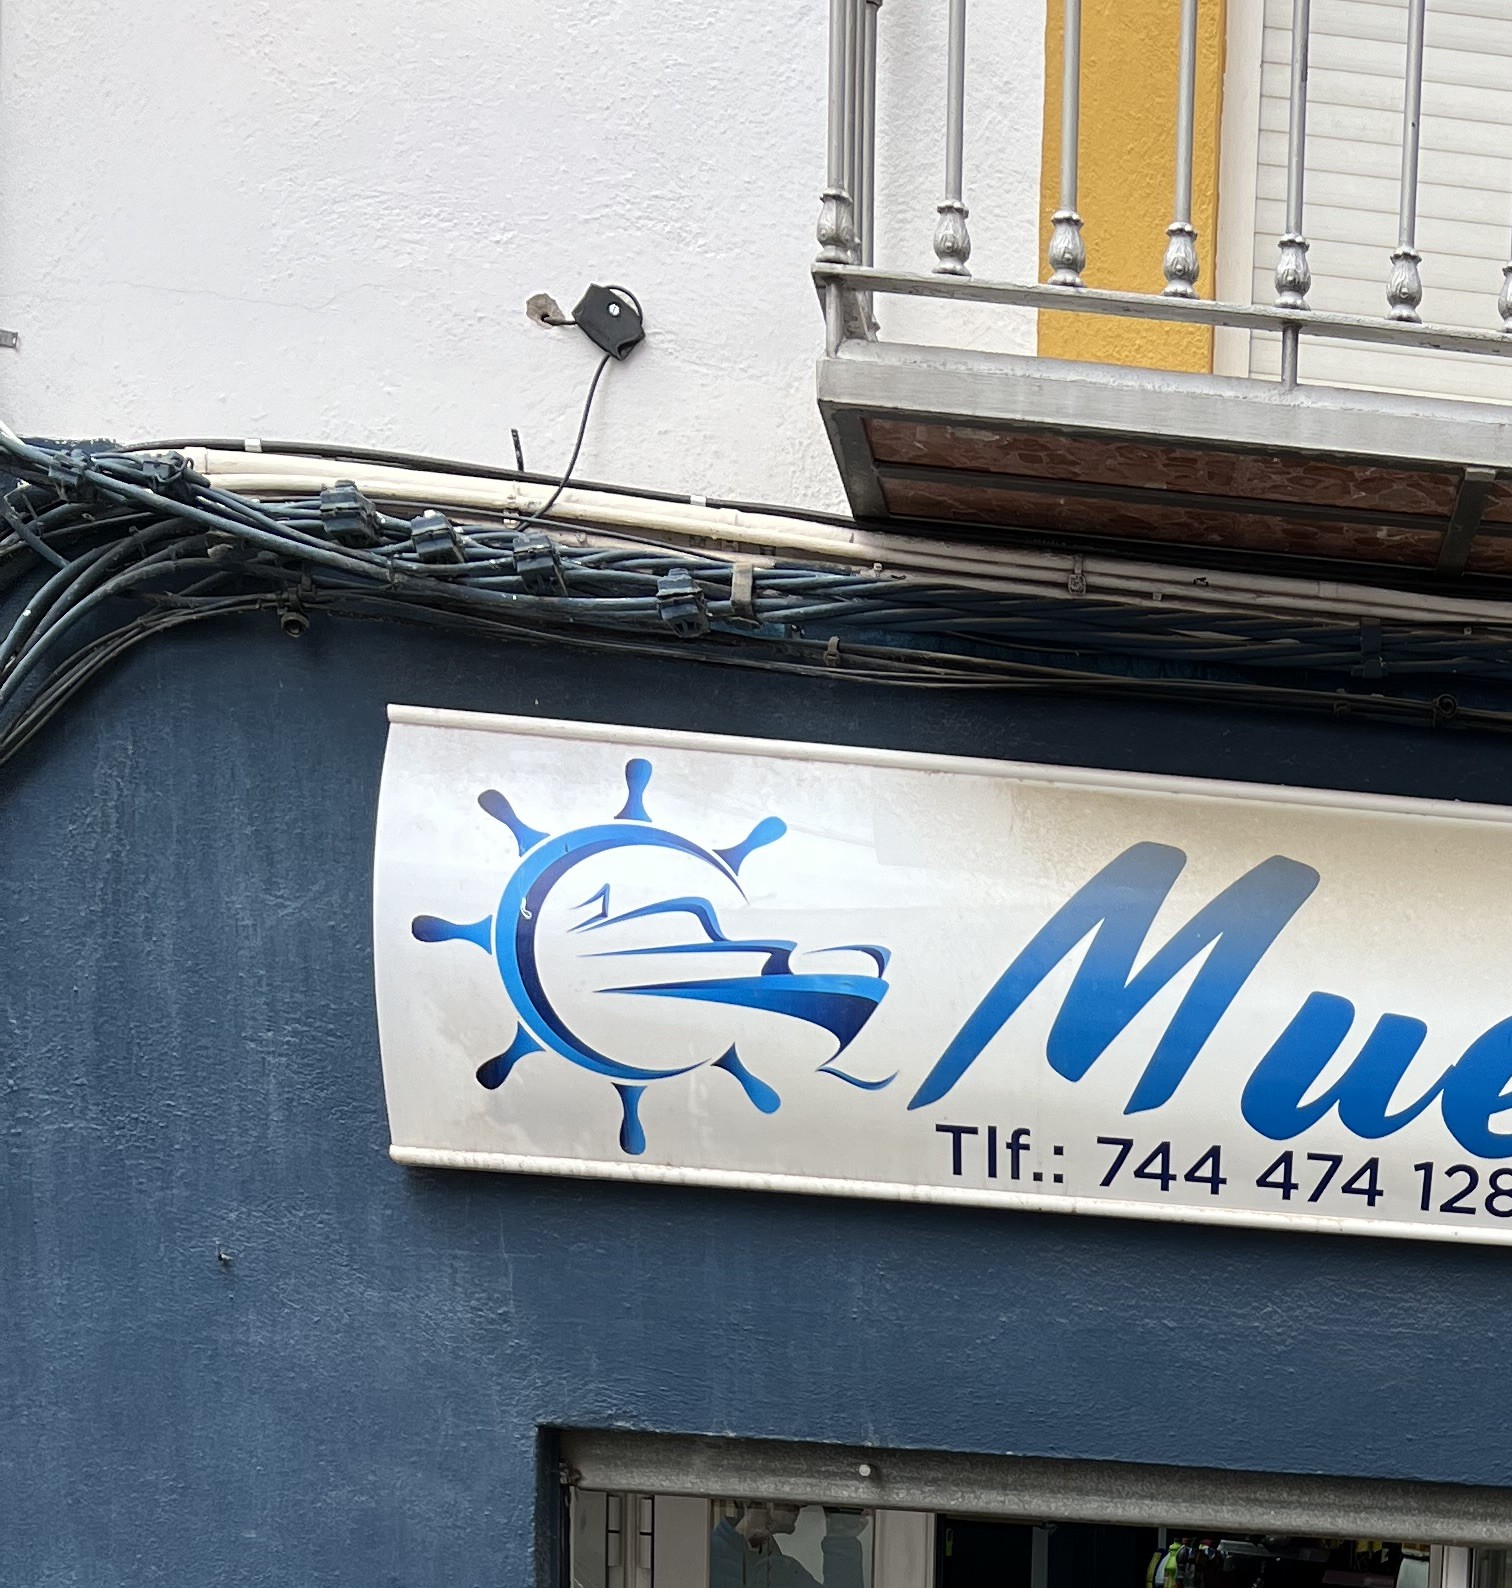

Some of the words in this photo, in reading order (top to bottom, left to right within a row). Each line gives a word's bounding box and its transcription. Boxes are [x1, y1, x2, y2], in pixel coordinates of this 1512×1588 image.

[935, 1123, 1064, 1184] Tlf.:
[1096, 1136, 1228, 1196] 744
[1255, 1150, 1384, 1208] 474
